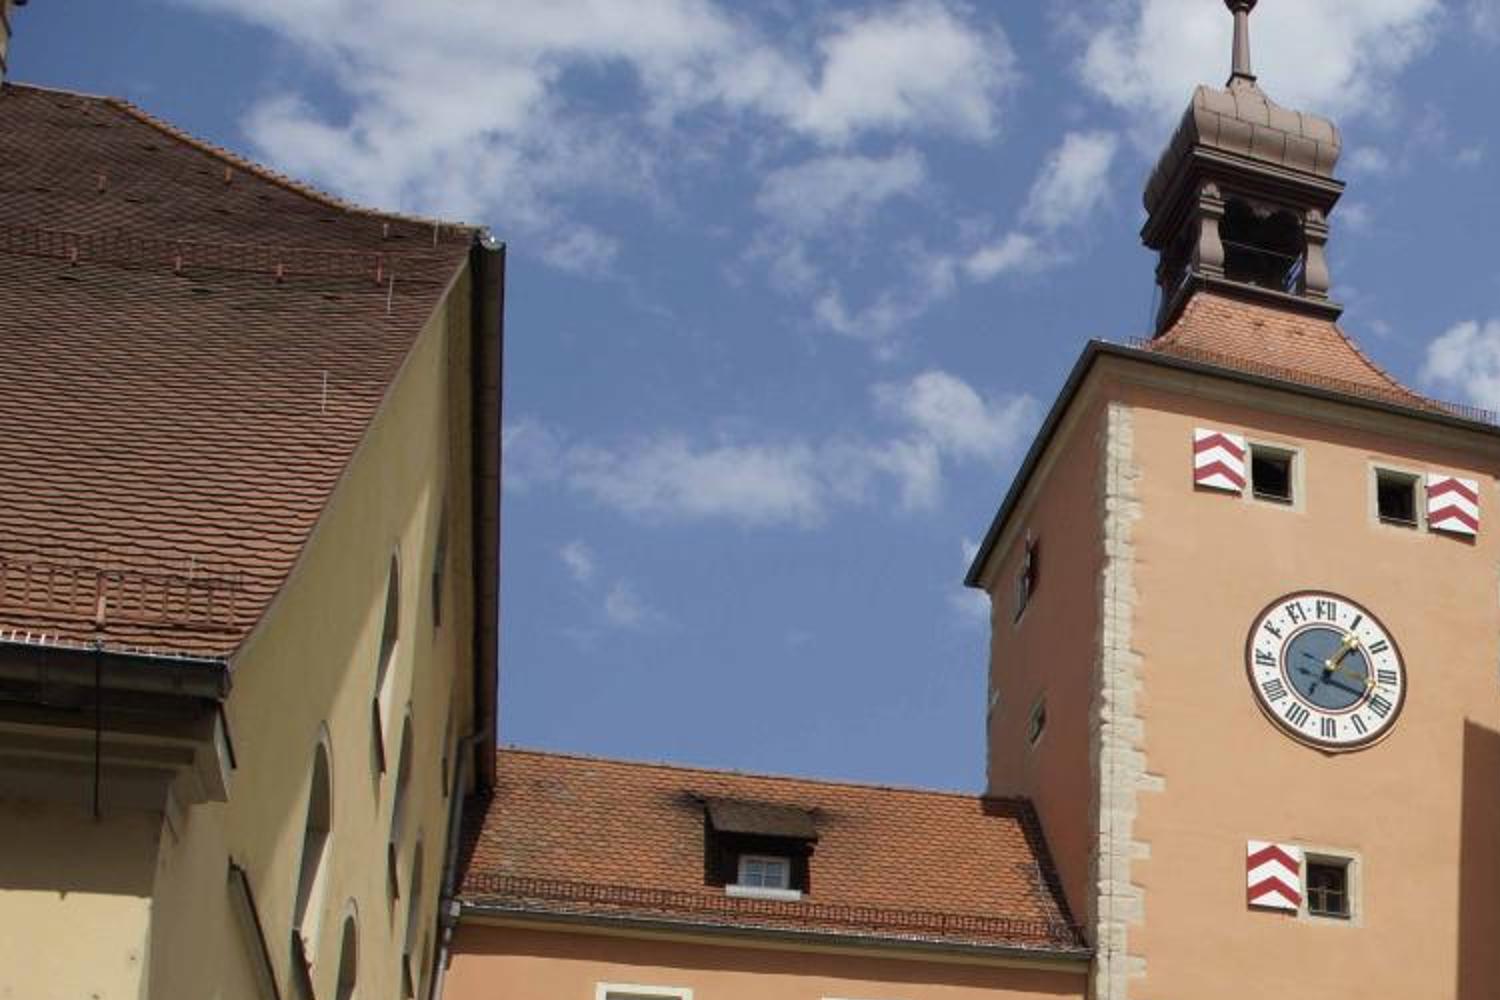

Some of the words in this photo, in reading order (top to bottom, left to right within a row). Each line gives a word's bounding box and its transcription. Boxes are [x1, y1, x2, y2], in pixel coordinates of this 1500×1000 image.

[1350, 615, 1362, 630] I
[1368, 640, 1388, 654] II
[1378, 669, 1396, 685] III
